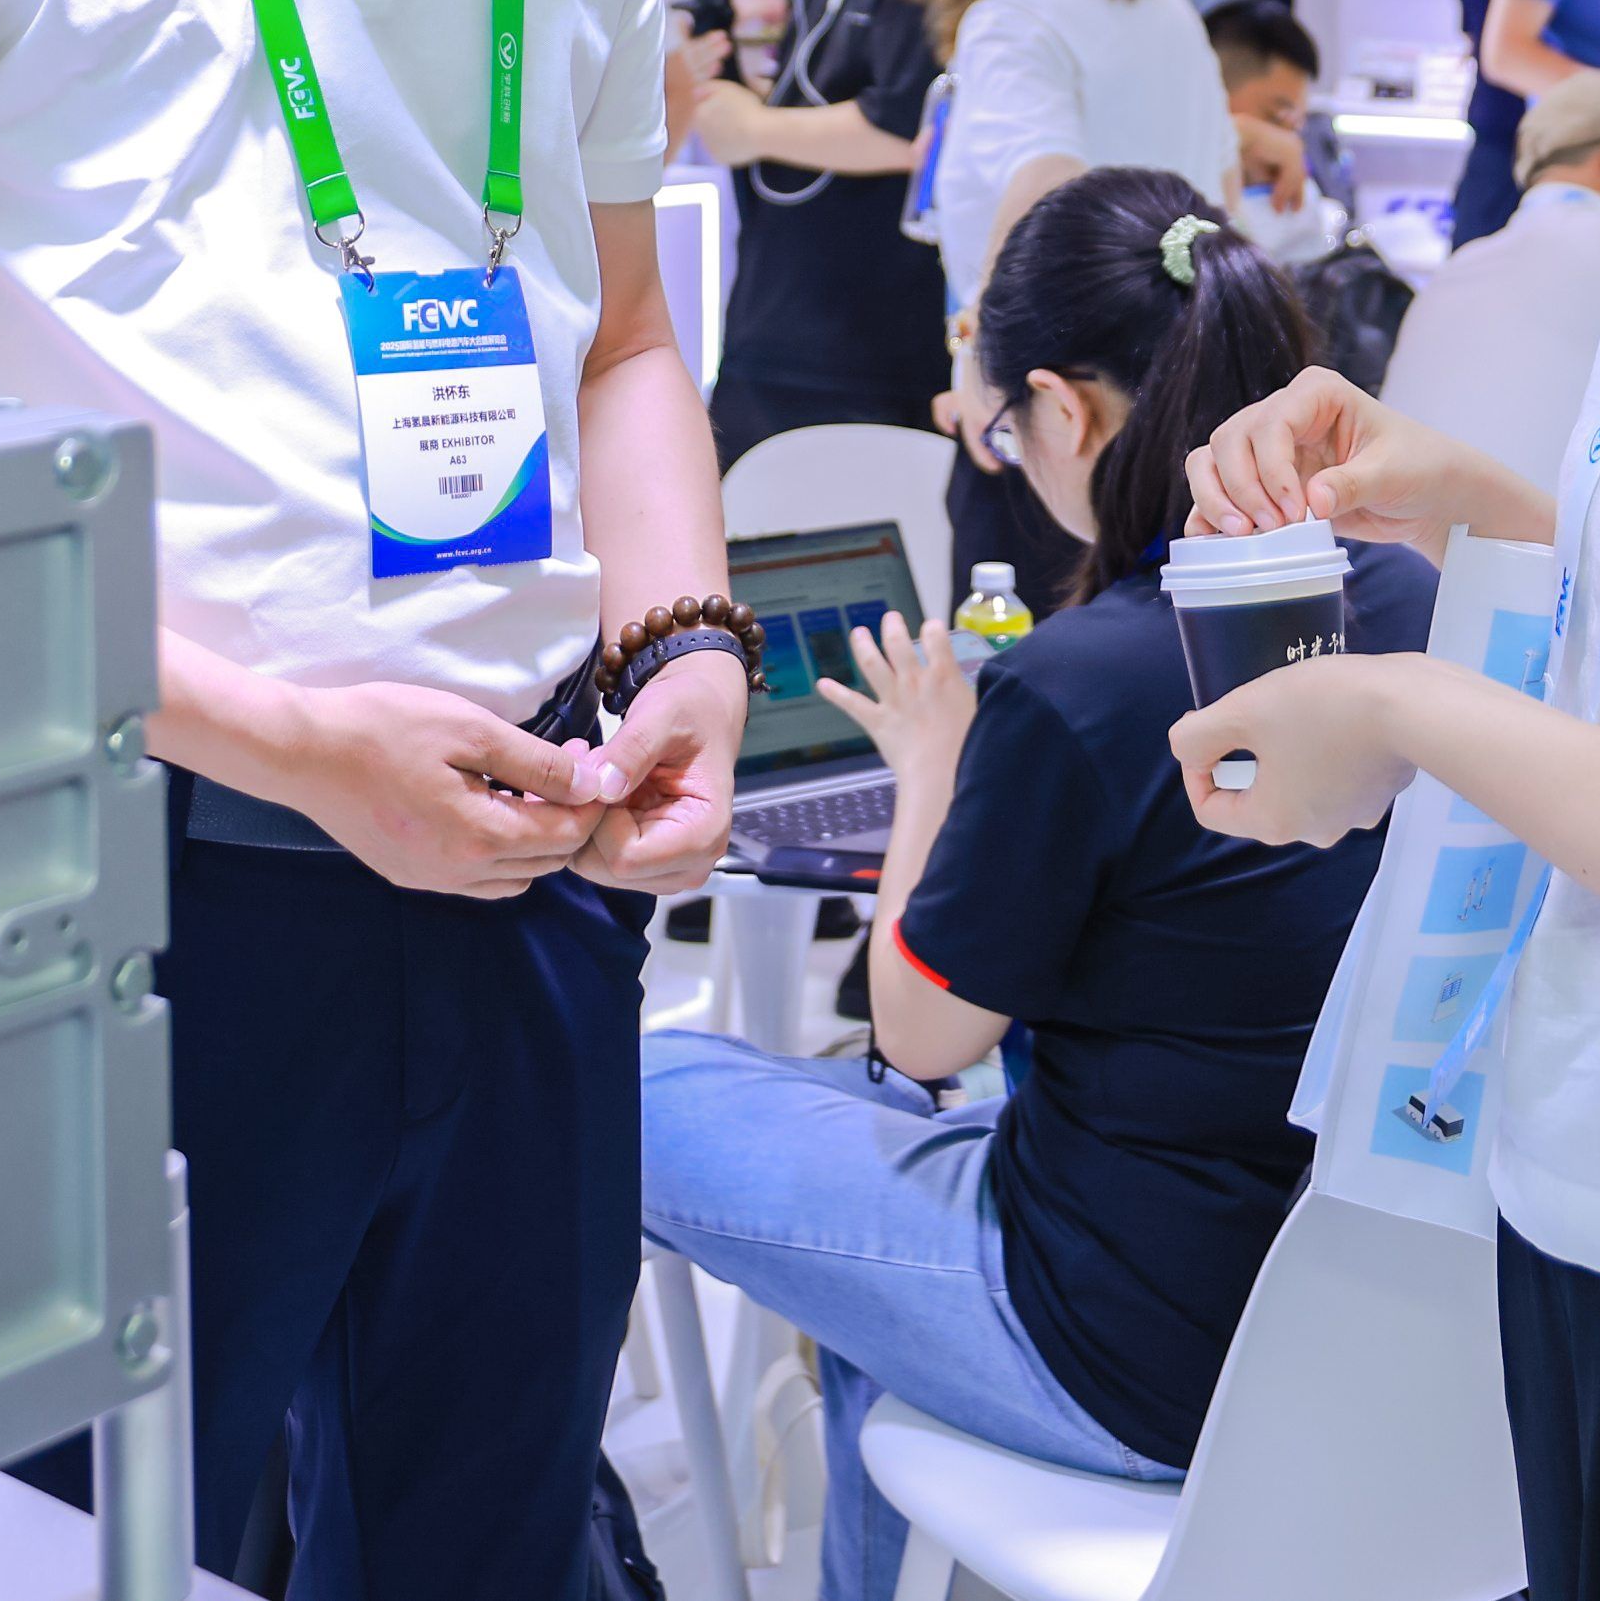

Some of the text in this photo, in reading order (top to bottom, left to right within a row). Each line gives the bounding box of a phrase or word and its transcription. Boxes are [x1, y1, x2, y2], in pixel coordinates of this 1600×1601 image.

[279, 56, 316, 120] FCVC
[402, 298, 479, 333] FCVC
[432, 384, 471, 401] 洪怀东
[420, 434, 495, 451] 展商 EXHIBITOR
[449, 455, 467, 465] A63
